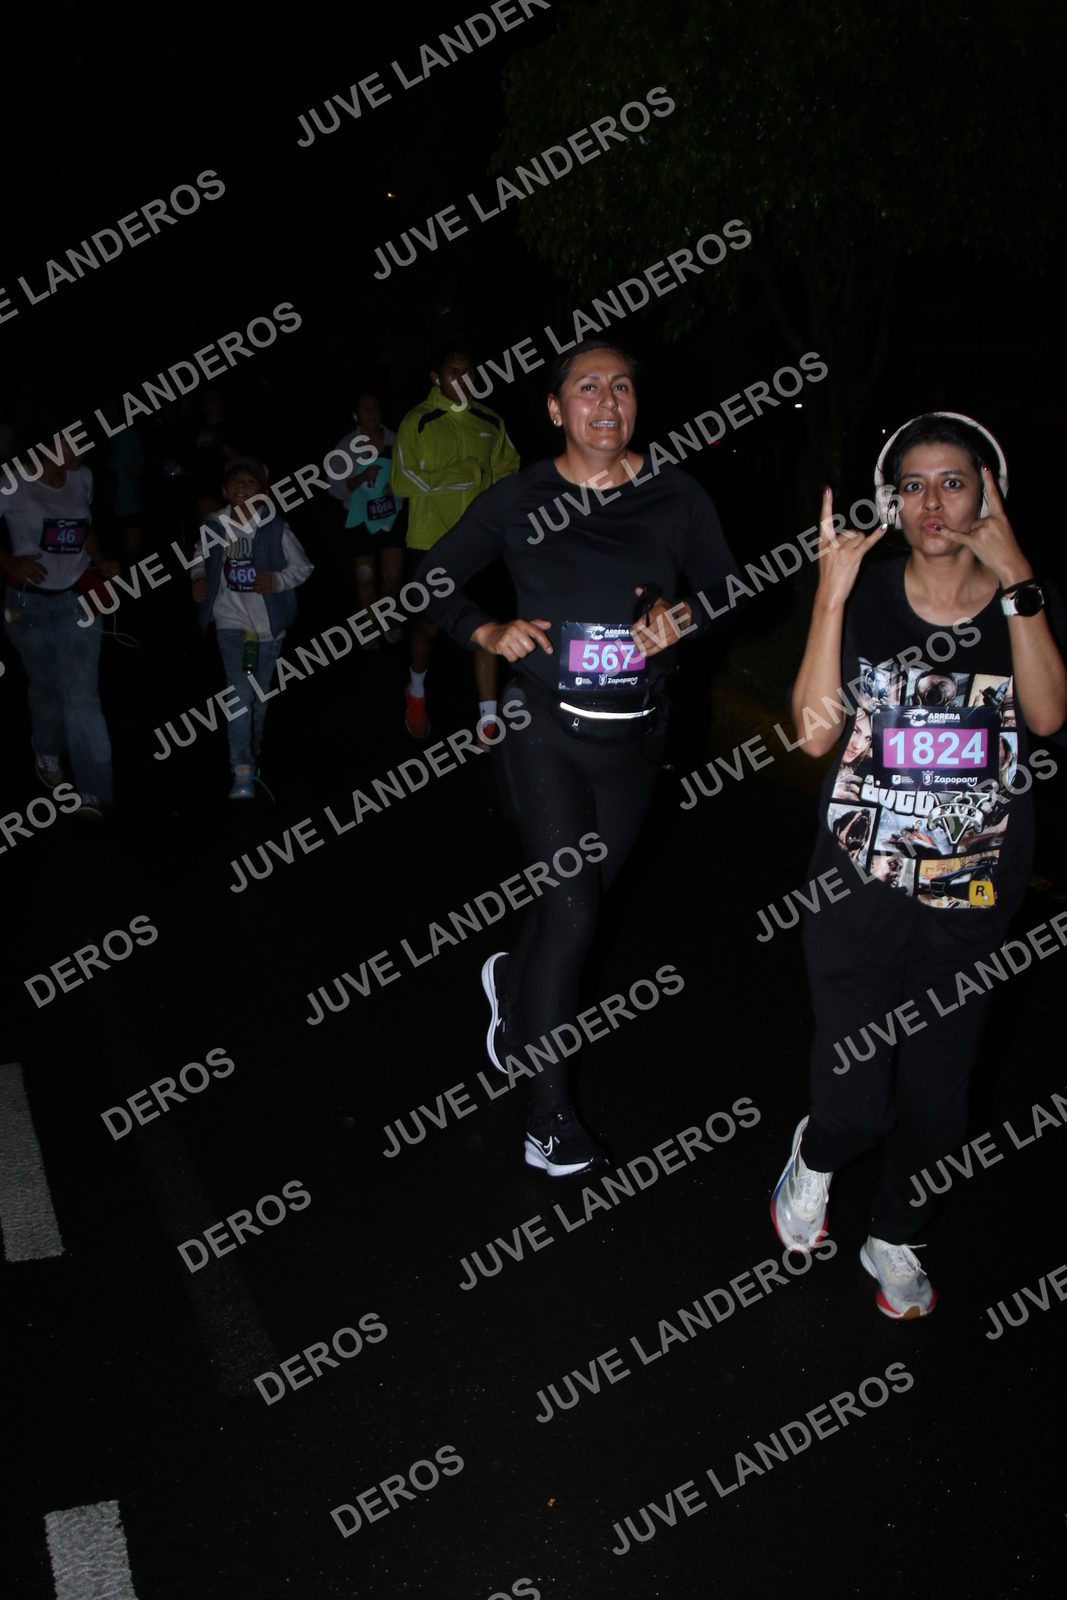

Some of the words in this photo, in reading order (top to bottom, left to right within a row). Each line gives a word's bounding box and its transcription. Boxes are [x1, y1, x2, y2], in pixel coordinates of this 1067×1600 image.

[56, 529, 76, 544] 46
[582, 644, 635, 671] 567
[903, 709, 960, 727] CARRERA
[889, 731, 984, 765] 1824
